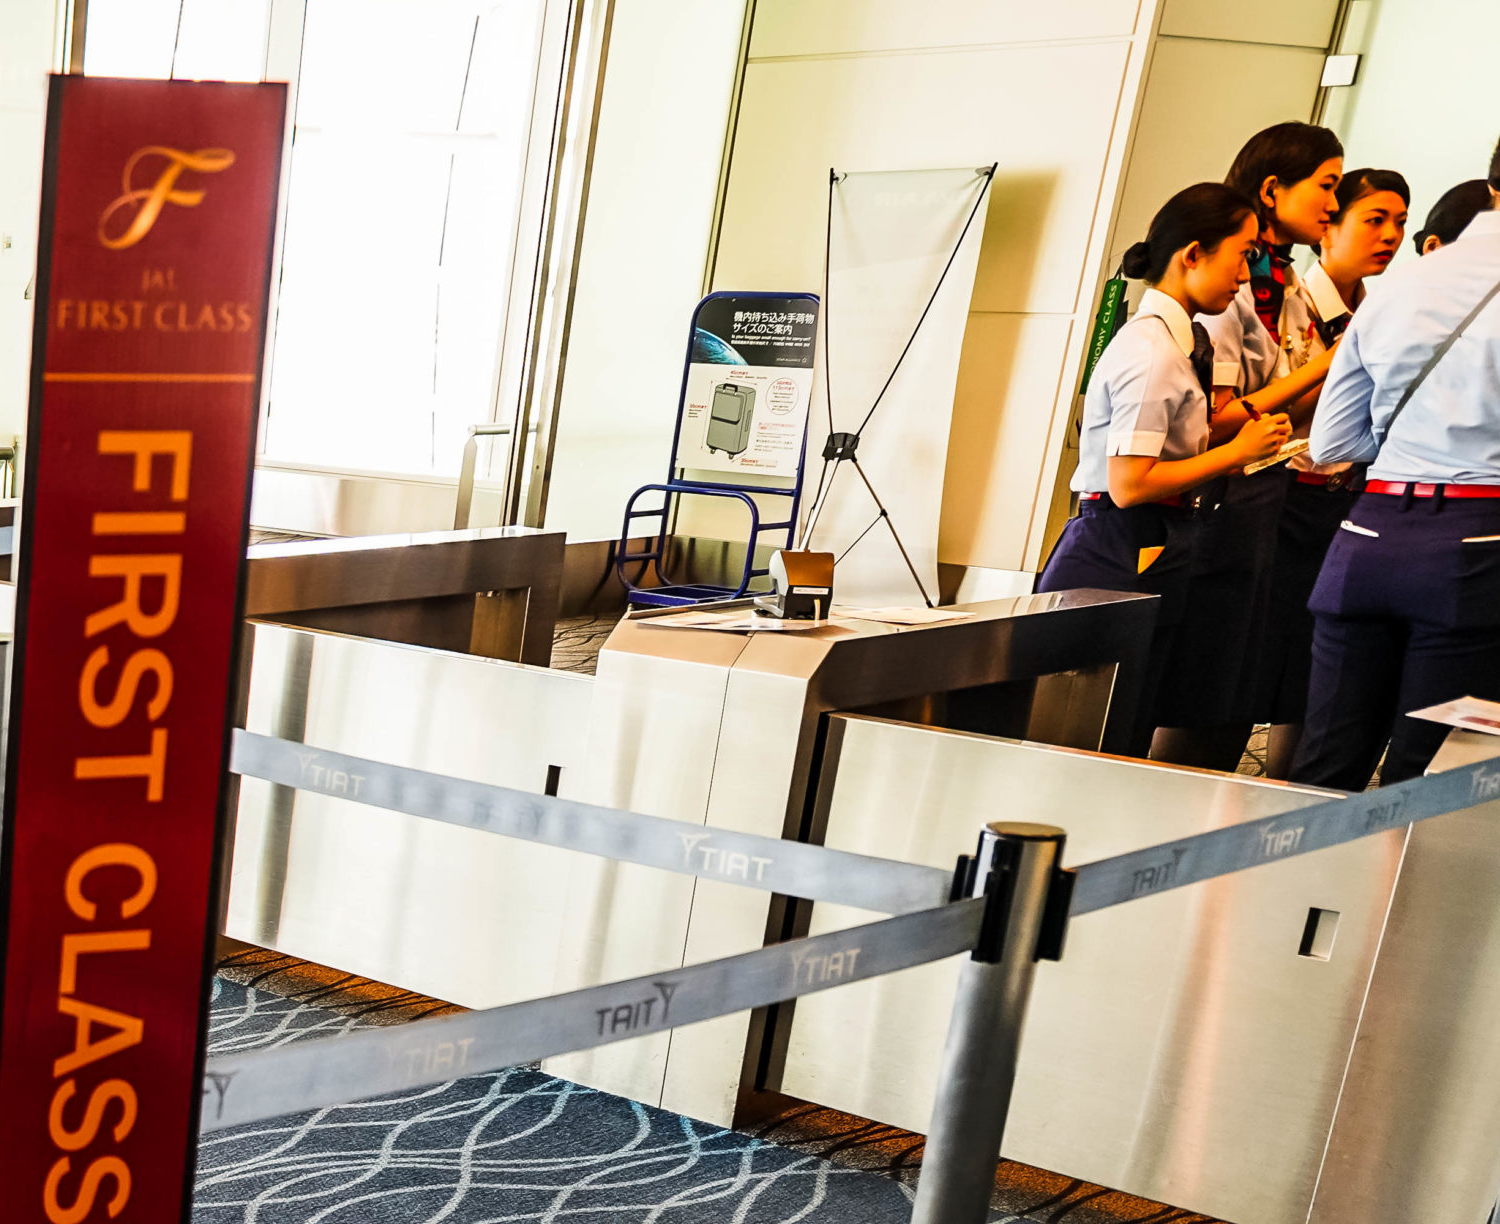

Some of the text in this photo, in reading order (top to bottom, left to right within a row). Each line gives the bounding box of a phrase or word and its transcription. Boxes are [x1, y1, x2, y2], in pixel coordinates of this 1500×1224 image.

[57, 299, 252, 332] FIRST CLASS
[734, 311, 815, 325] 機内持ち込み手荷物
[1103, 284, 1117, 324] CLASS
[732, 323, 793, 336] サイズのご案内
[74, 429, 193, 802] FIRST
